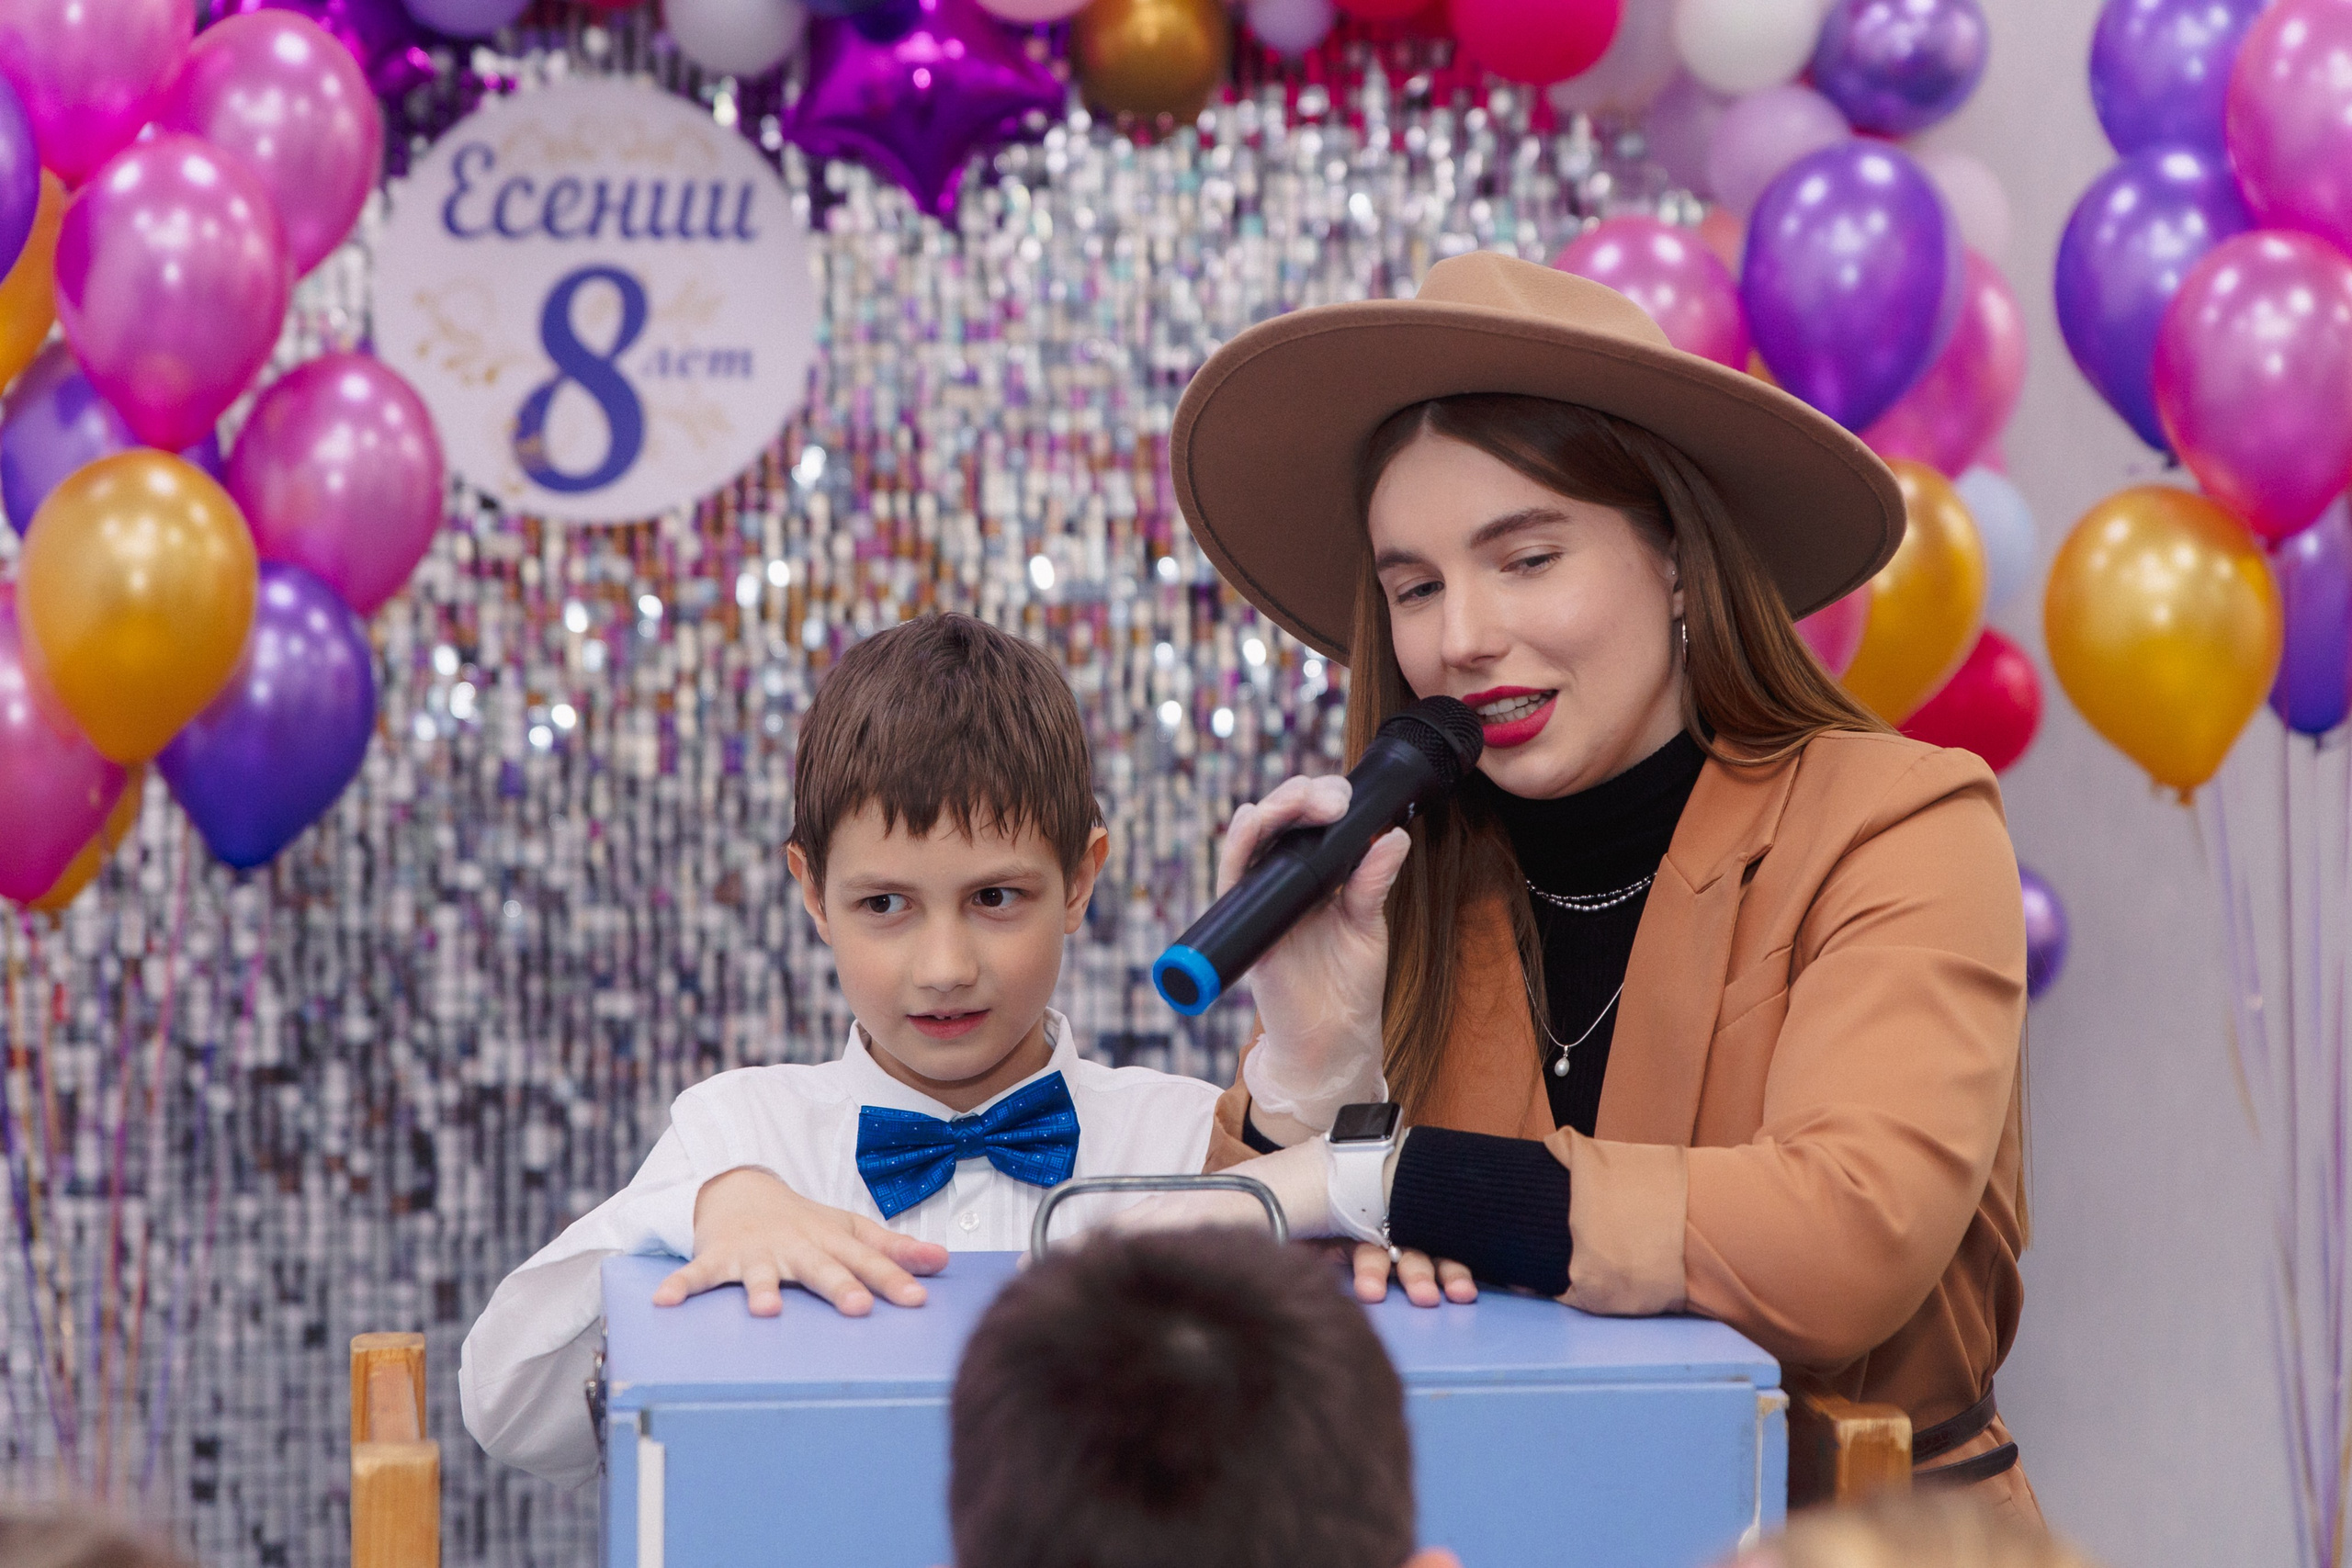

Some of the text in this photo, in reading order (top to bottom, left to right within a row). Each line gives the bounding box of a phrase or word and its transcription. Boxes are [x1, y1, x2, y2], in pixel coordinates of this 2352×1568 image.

[442, 142, 759, 242] Есении
[513, 264, 754, 493] 8 лет
